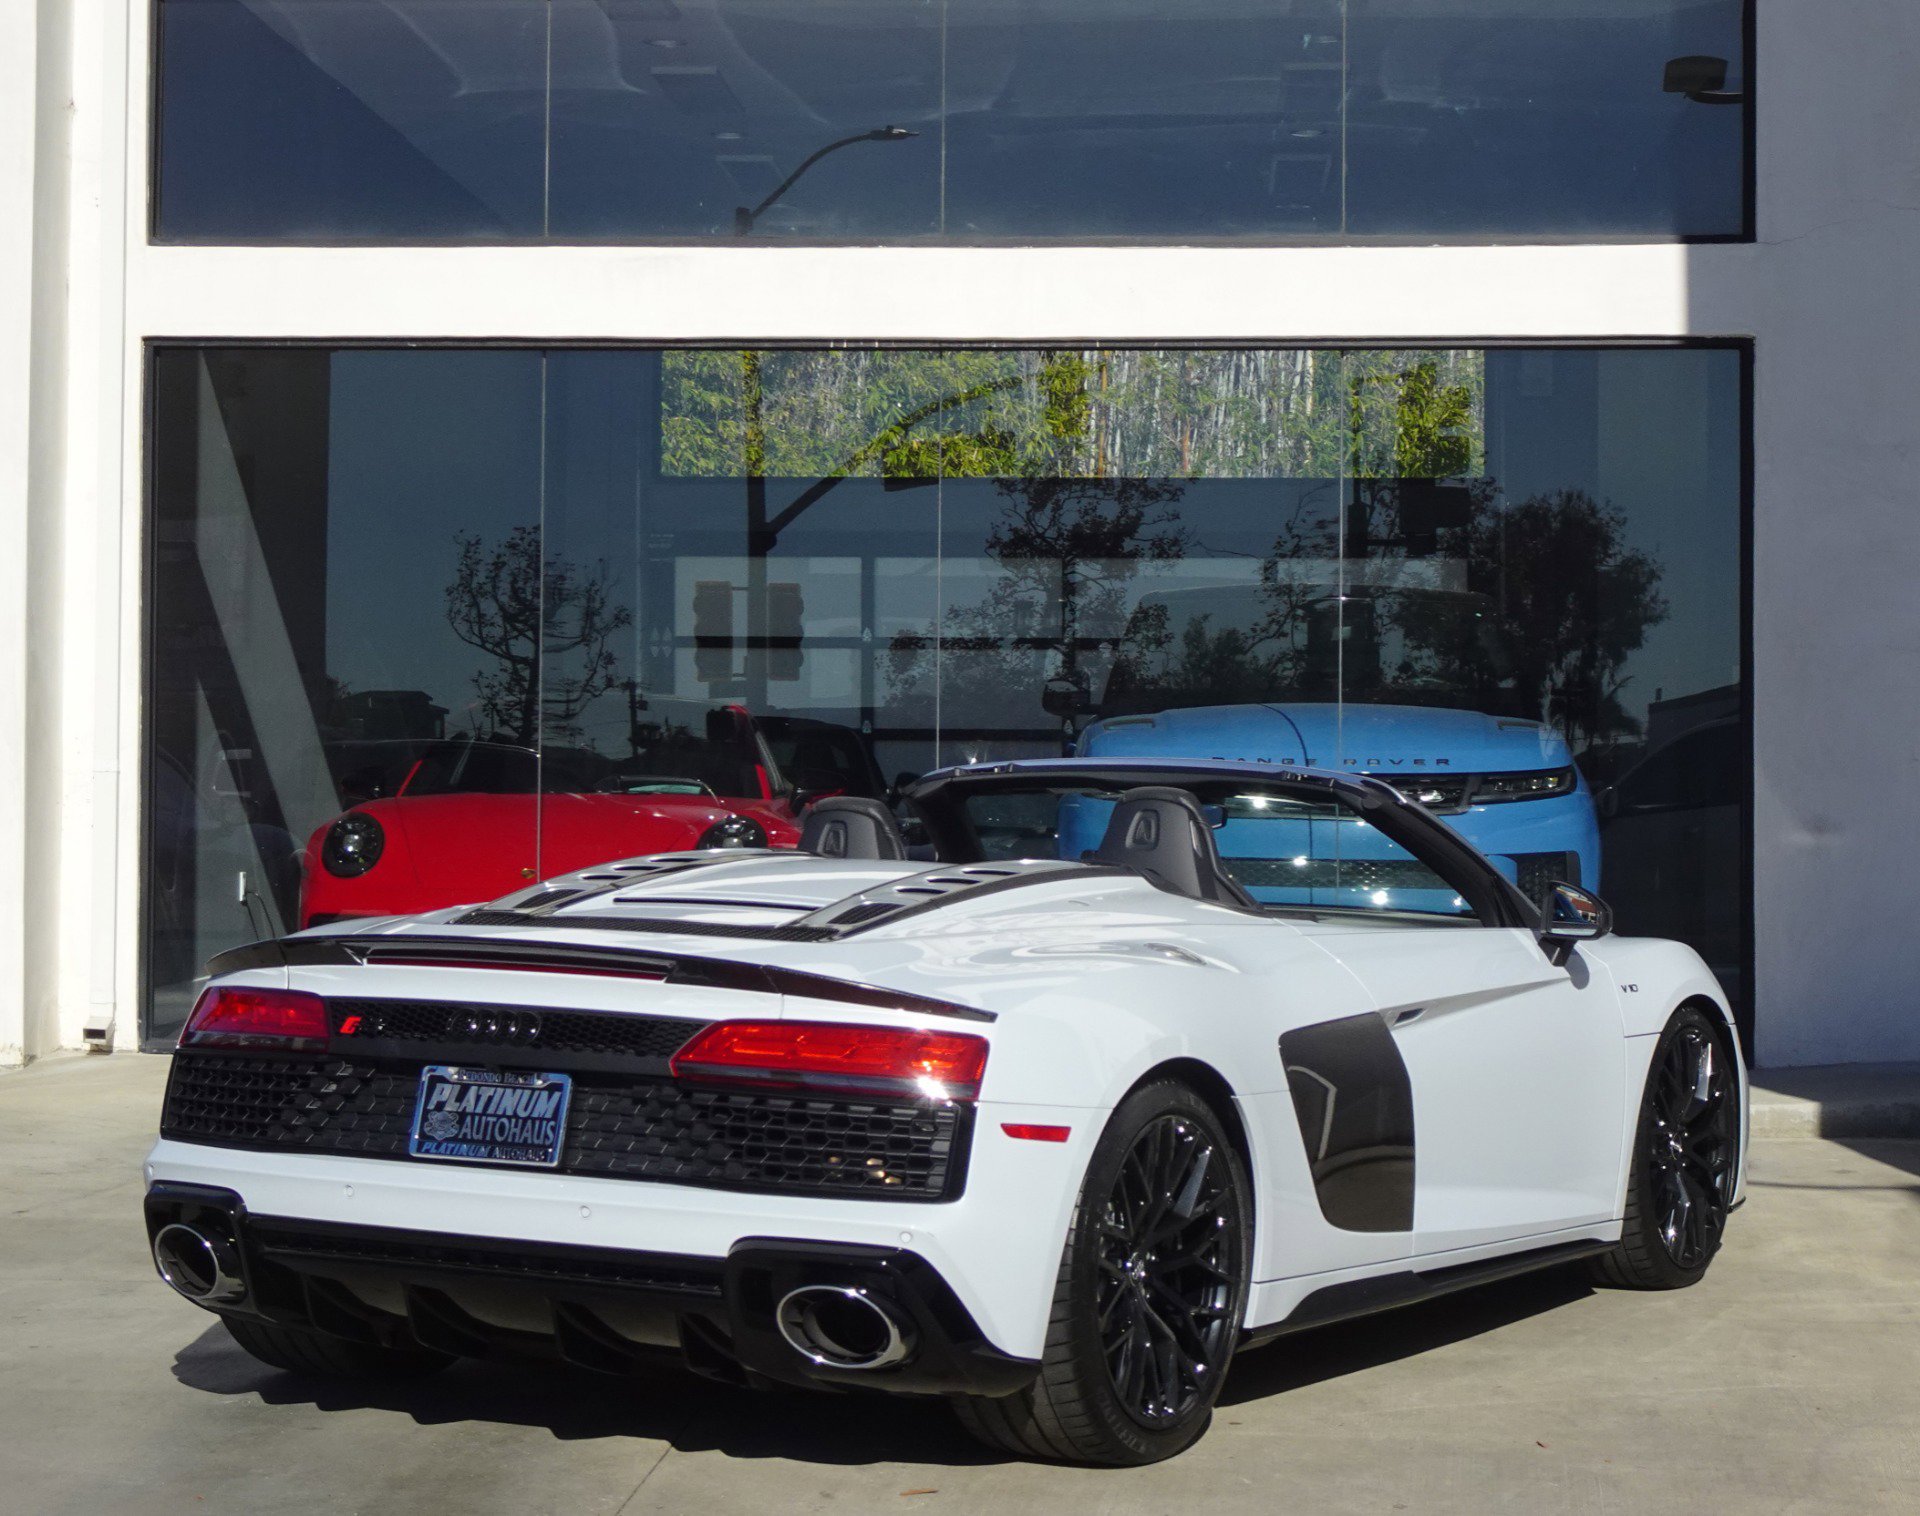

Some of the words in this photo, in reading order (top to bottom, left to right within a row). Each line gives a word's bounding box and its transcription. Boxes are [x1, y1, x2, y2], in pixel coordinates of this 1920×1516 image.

[1343, 758, 1450, 766] ROVER
[1620, 983, 1639, 993] V10
[427, 1083, 562, 1118] PLATINUM
[458, 1115, 556, 1145] AUTOHAUS
[421, 1142, 491, 1157] PLATINUM
[493, 1147, 545, 1161] AUTOHAUS
